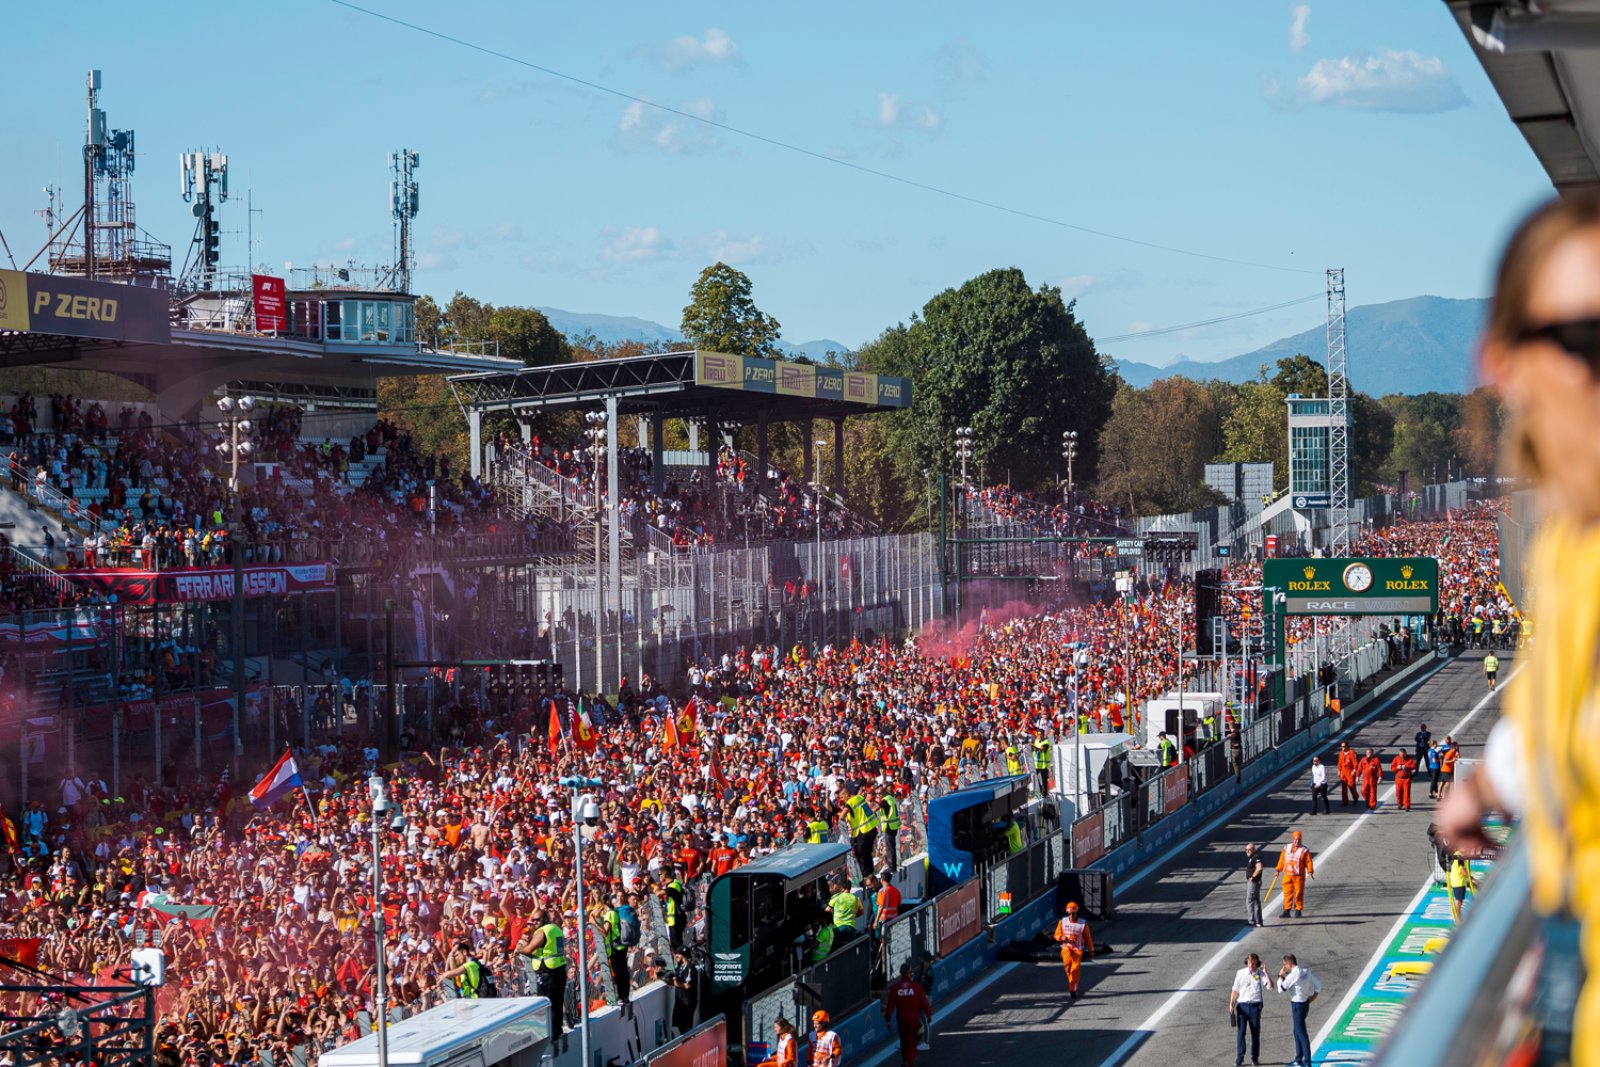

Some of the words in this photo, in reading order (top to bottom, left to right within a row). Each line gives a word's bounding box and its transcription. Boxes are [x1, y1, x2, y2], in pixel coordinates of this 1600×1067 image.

[33, 291, 50, 314] P
[55, 293, 118, 322] ZERO
[704, 357, 725, 381] PIRELLI
[745, 367, 751, 380] P
[752, 368, 774, 382] ZERO
[817, 376, 822, 389] P
[823, 377, 842, 391] ZERO
[879, 384, 884, 396] P
[884, 384, 900, 398] ZERO
[1288, 581, 1331, 590] ROLEX
[1386, 580, 1429, 590] ROLEX
[1307, 601, 1356, 609] RACE
[943, 863, 963, 878] W
